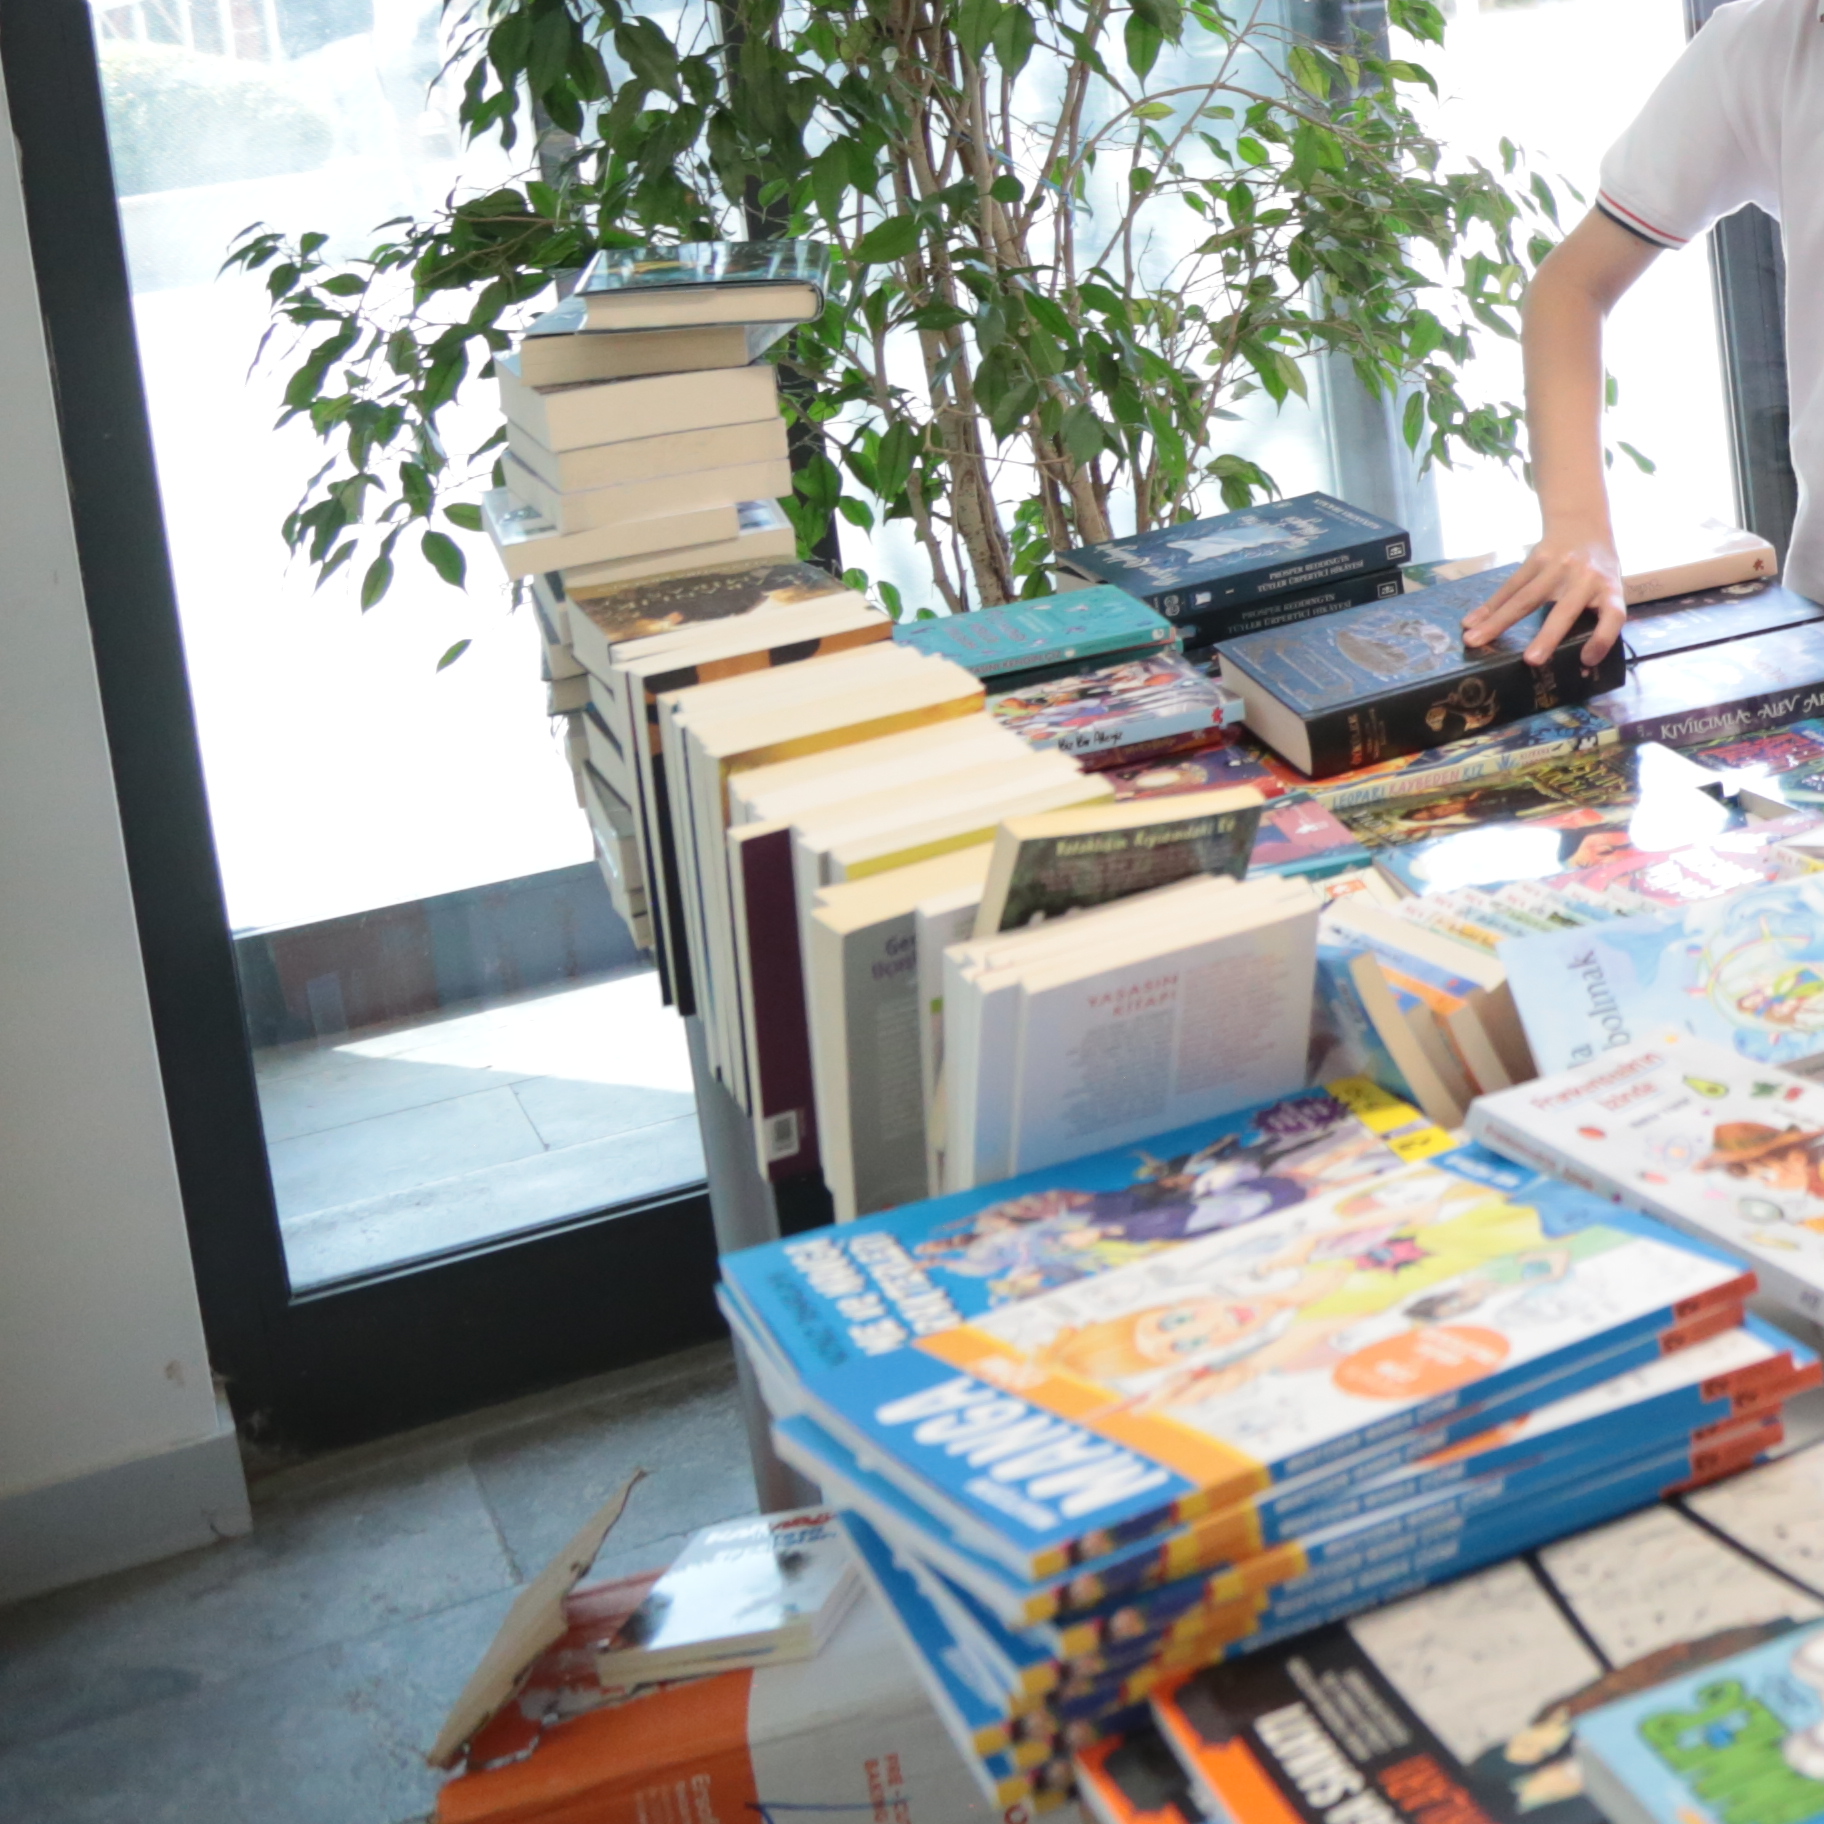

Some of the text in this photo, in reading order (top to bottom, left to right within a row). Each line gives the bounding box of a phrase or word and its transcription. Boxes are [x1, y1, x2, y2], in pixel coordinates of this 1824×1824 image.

[1659, 710, 1752, 741] KIVILCIMLA
[1757, 695, 1799, 719] ALEV
[1332, 763, 1485, 810] LEOPARI KAYBEDEN KIZ
[874, 1366, 1172, 1524] MANGA
